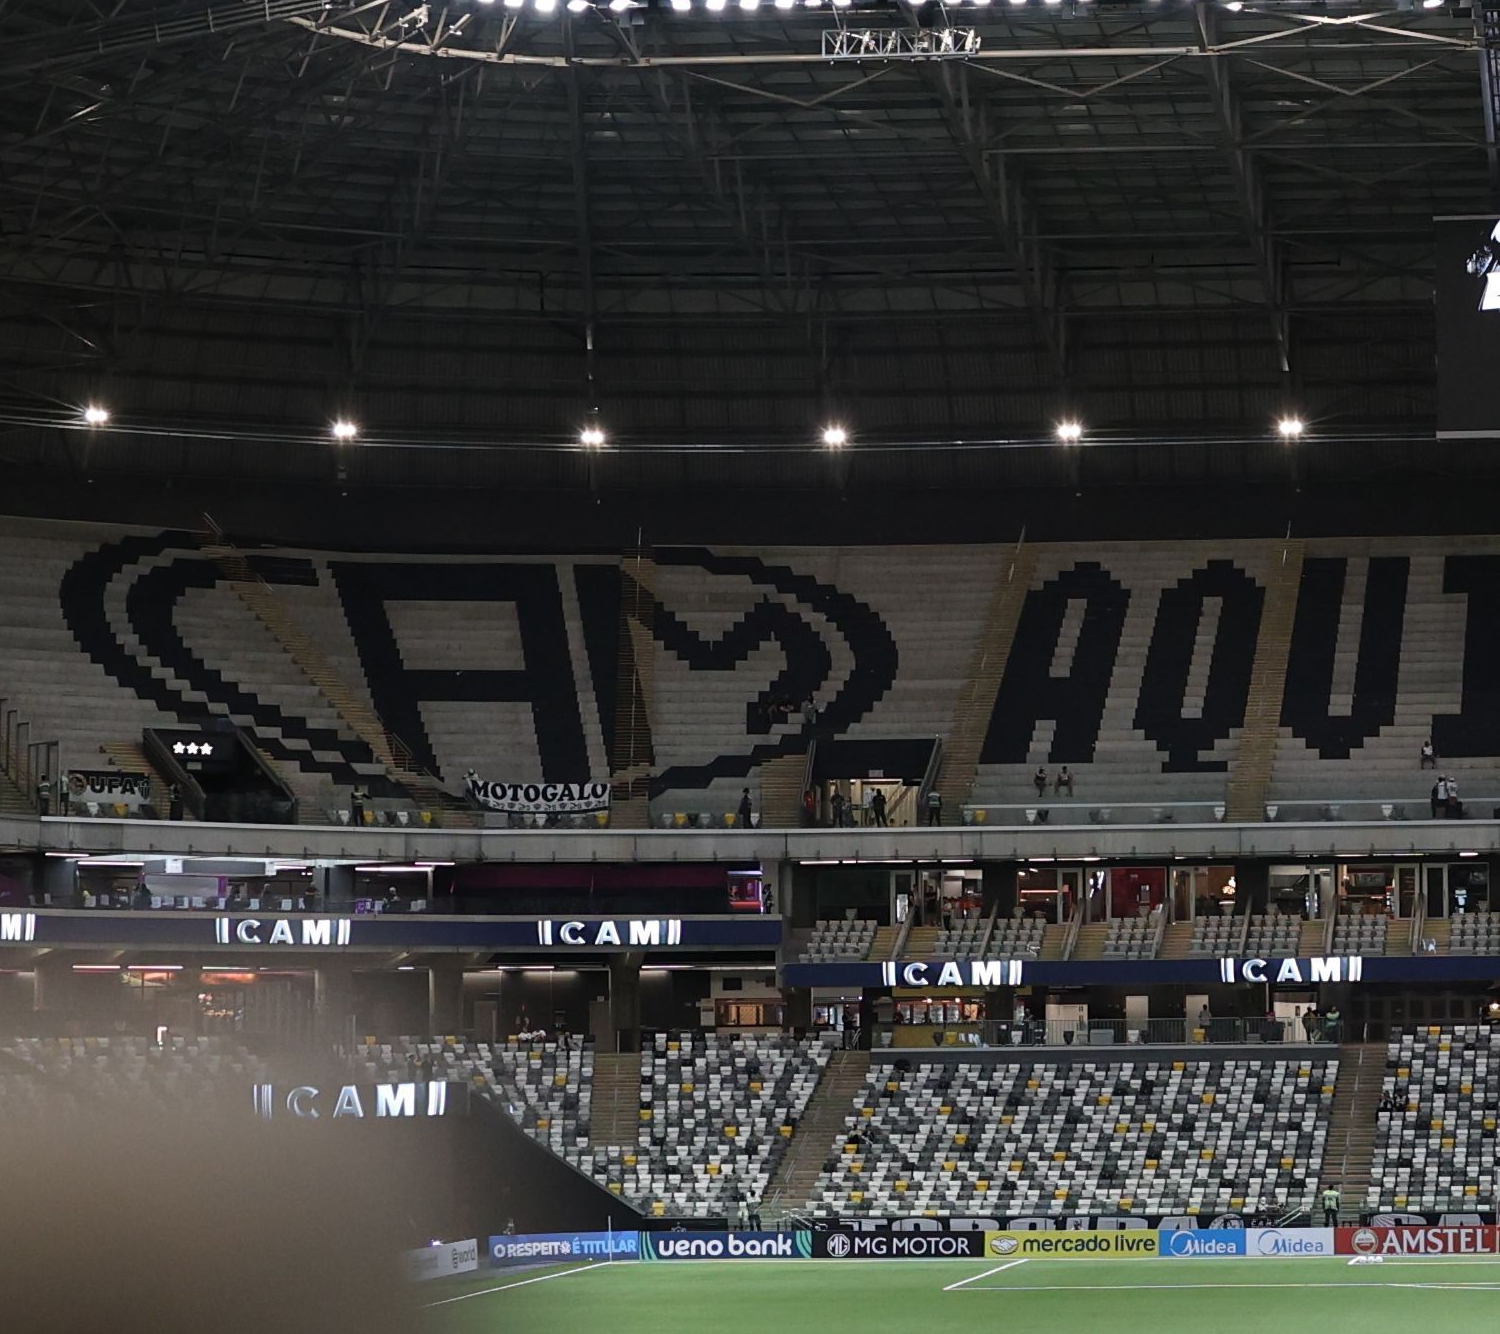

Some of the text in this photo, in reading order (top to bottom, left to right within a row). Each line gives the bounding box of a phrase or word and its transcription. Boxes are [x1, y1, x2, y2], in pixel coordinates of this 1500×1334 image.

[89, 775, 136, 795] UFA
[471, 780, 608, 803] MOTOGALO
[237, 920, 331, 944] CAM
[560, 920, 660, 944] CAM
[904, 961, 1001, 986] CAM
[1243, 957, 1340, 982] CAM
[286, 1083, 415, 1117] CAM
[494, 1244, 506, 1257] O
[572, 1237, 581, 1254] É
[581, 1238, 637, 1254] TITULAR
[658, 1234, 792, 1255] ueno bank
[854, 1236, 886, 1255] MG
[893, 1236, 971, 1255] MOTOR
[1023, 1234, 1156, 1252] mercado livre
[1180, 1237, 1237, 1254] Midea
[1272, 1237, 1324, 1253] Midea
[1382, 1227, 1490, 1254] AMSTEL
[459, 1246, 476, 1264] world
